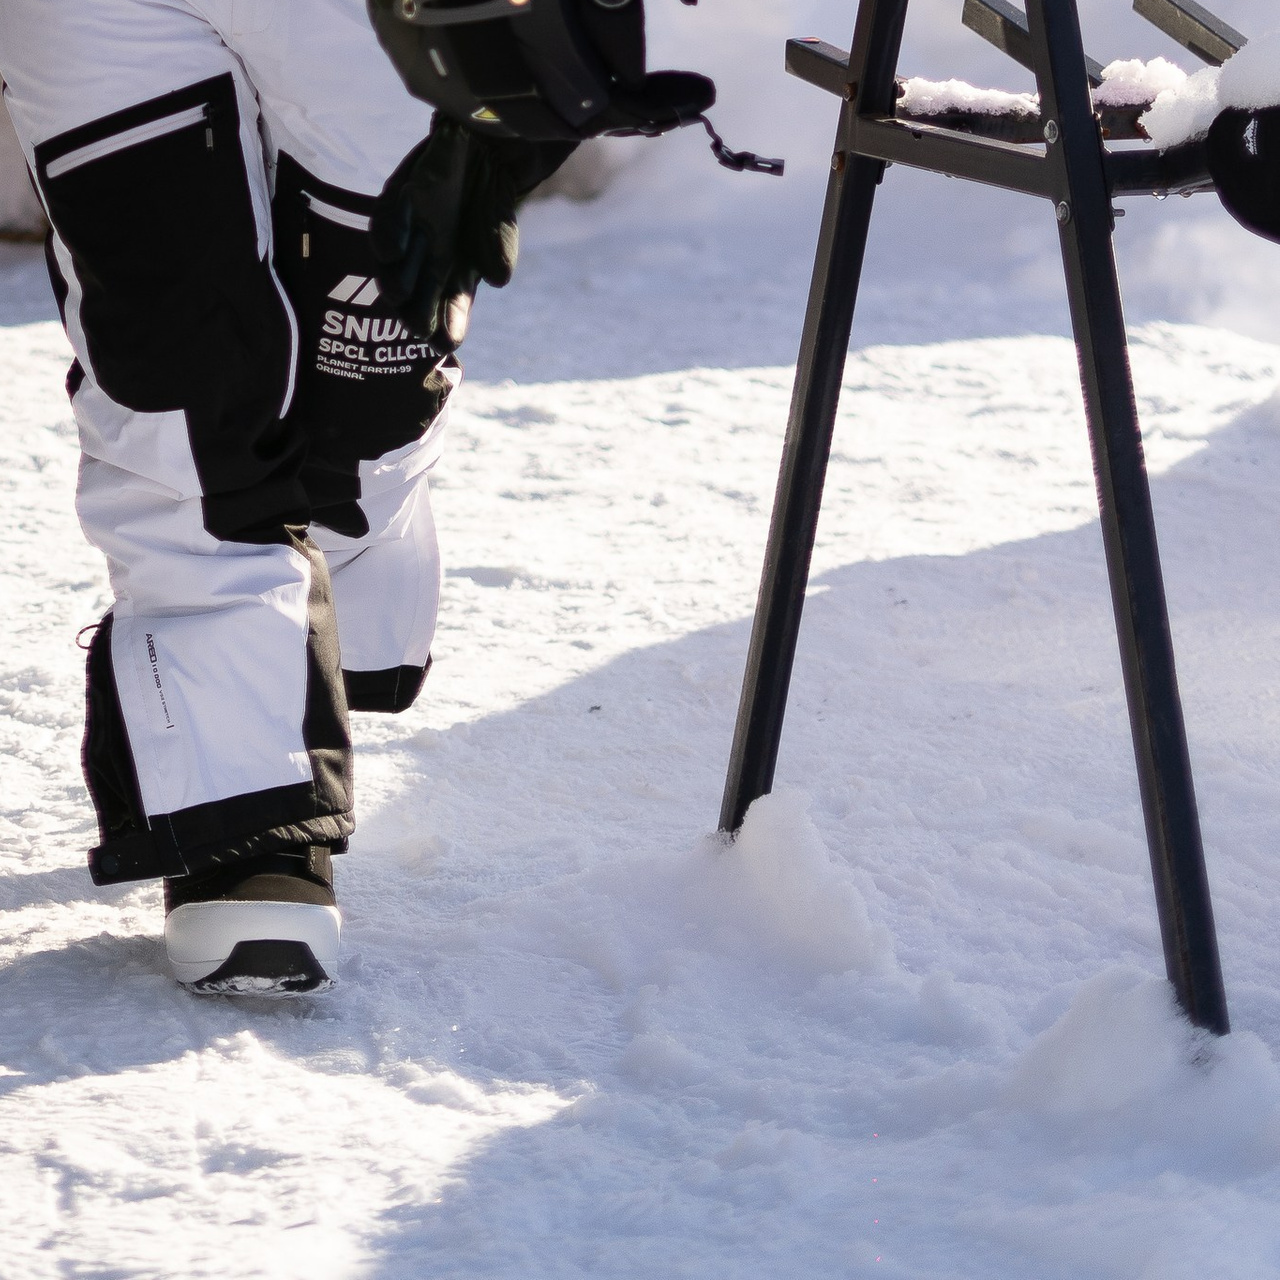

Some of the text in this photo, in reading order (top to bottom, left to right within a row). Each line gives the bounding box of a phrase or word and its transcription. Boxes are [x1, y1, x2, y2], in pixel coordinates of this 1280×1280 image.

[318, 337, 369, 361] SPCL
[315, 363, 365, 381] ORIGINAL
[317, 354, 412, 375] PLANET EARTH-99
